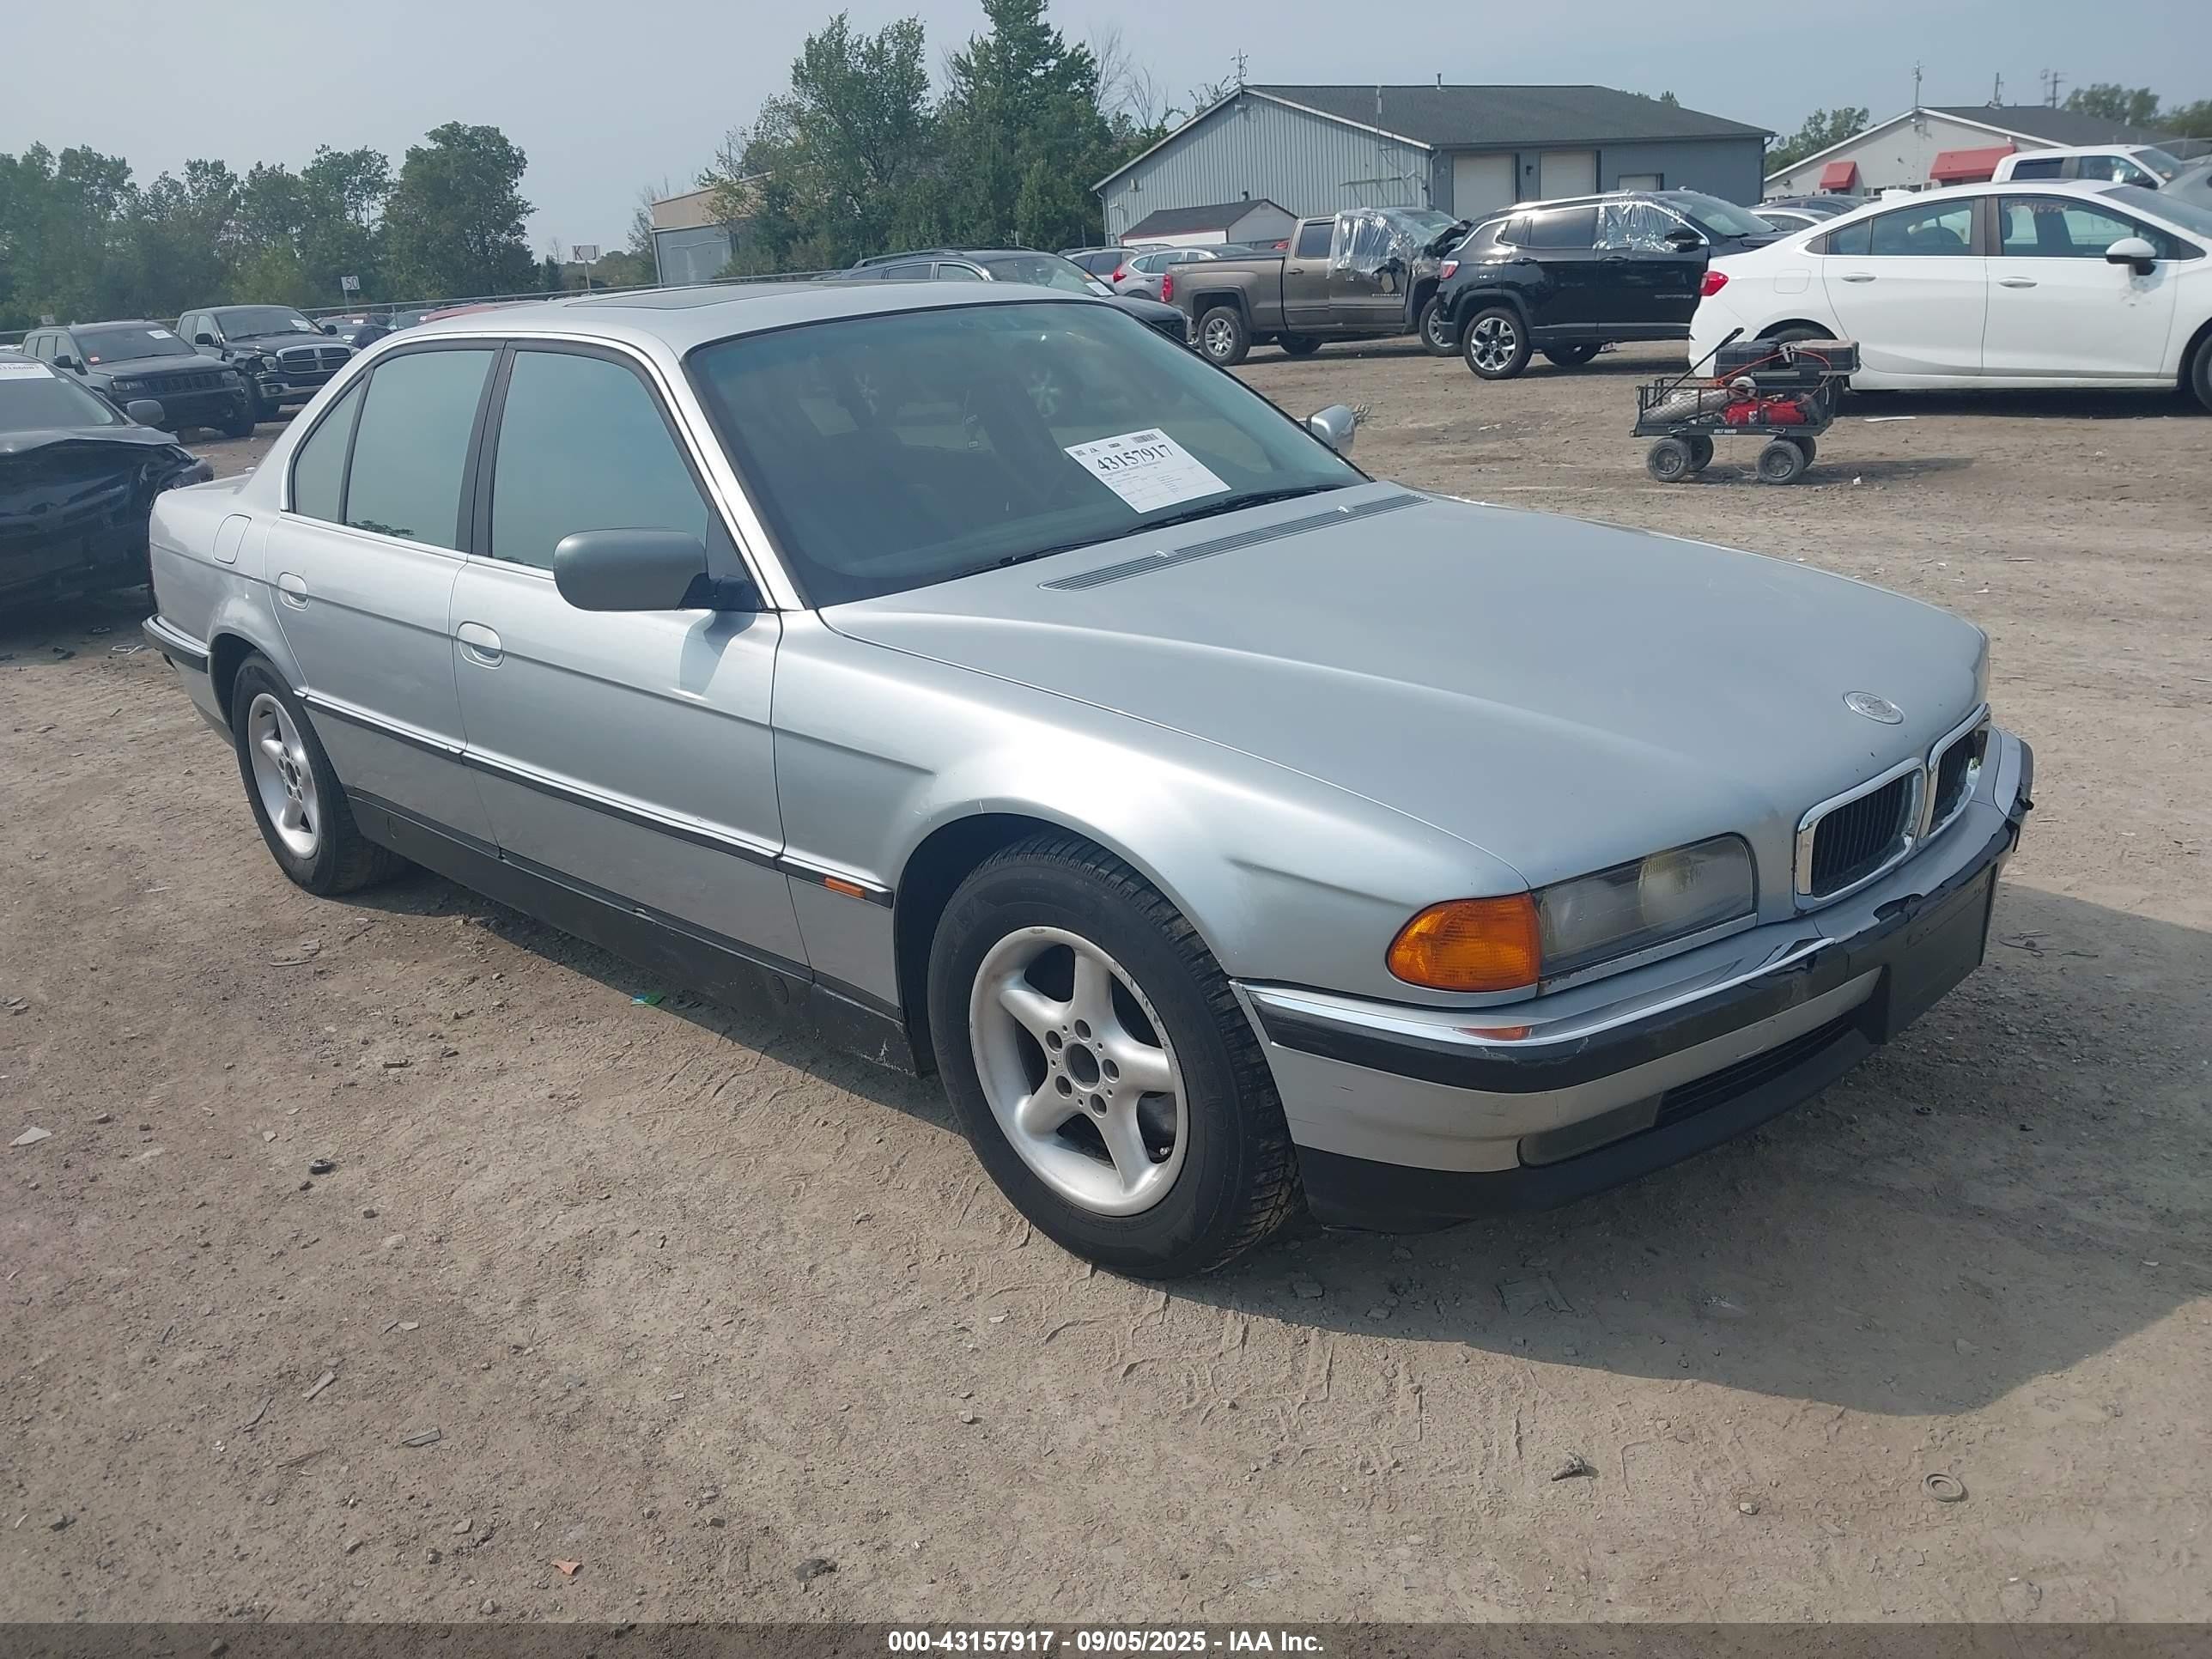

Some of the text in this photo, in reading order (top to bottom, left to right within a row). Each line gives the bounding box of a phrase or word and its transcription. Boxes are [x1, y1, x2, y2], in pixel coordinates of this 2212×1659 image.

[574, 245, 583, 260] K
[345, 276, 359, 289] 50
[1097, 444, 1173, 471] 43157917
